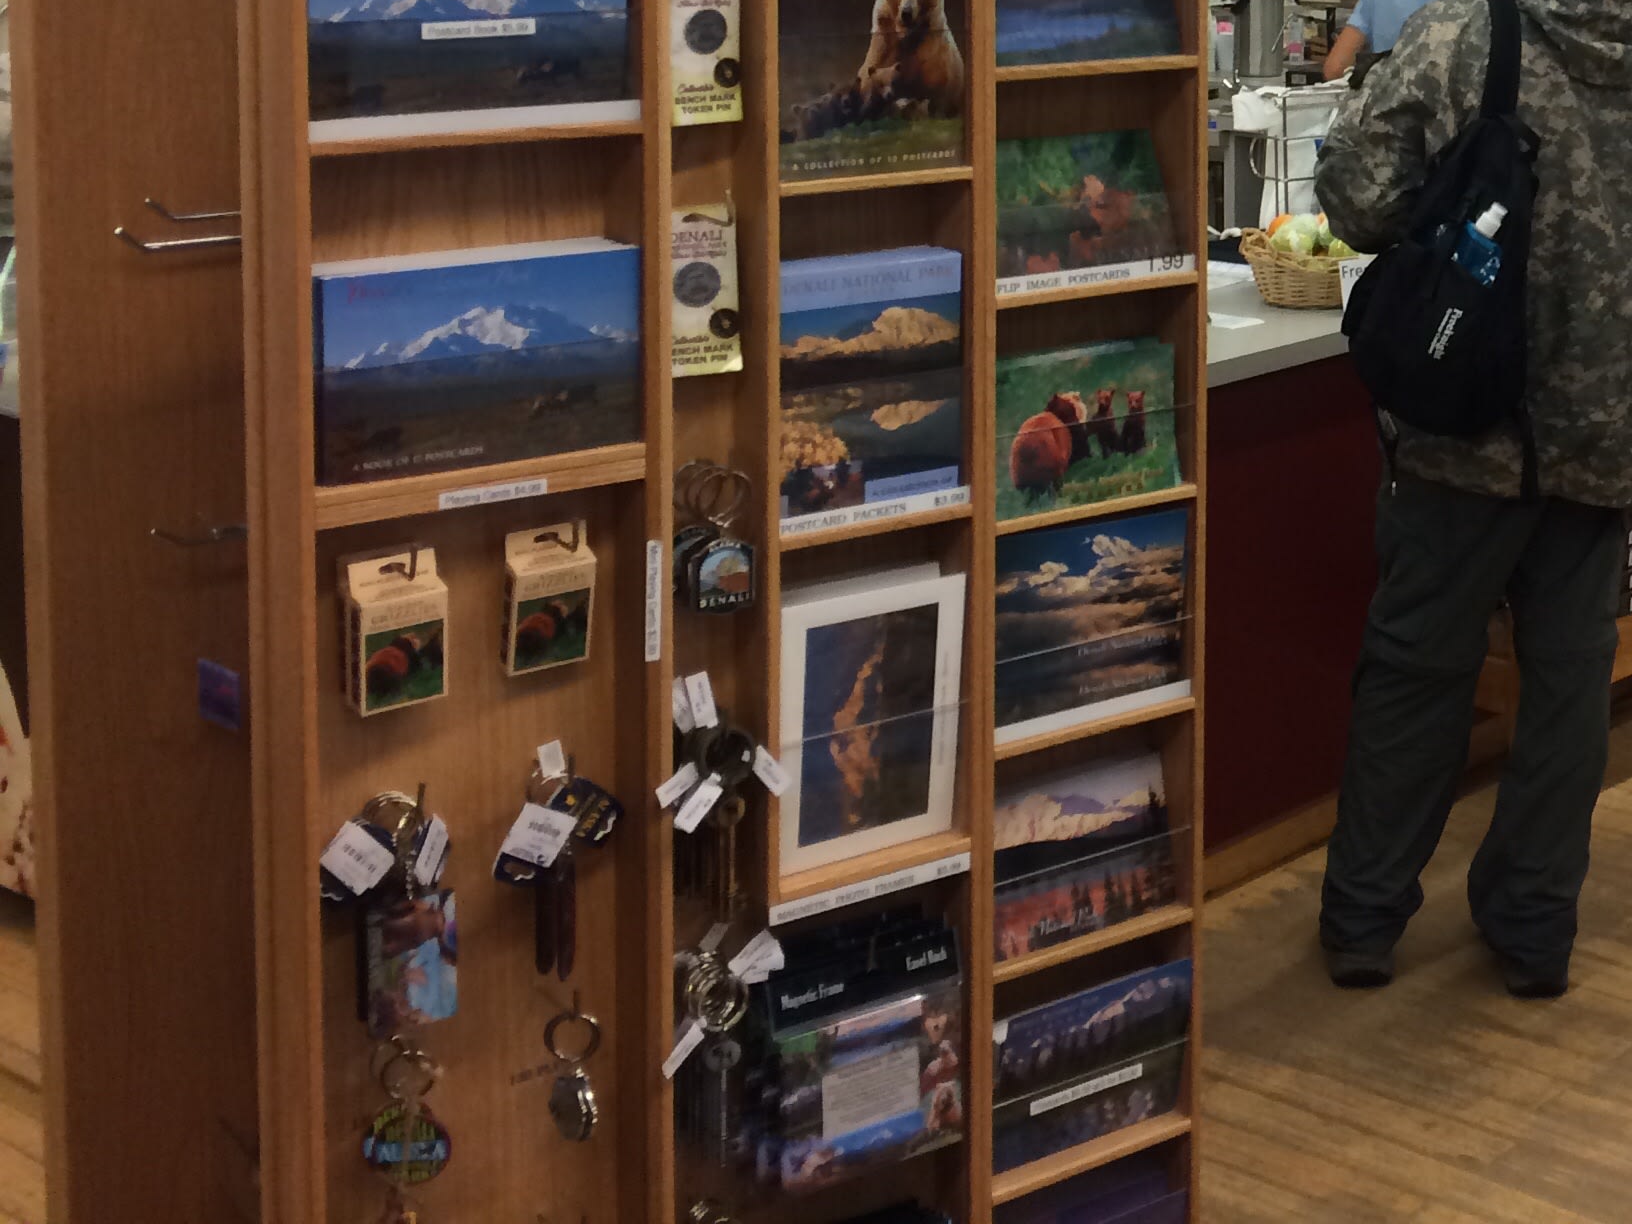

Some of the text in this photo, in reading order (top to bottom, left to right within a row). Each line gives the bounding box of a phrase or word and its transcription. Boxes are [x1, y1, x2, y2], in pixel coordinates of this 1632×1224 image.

[674, 93, 737, 106] BENCH MARK
[681, 102, 732, 115] TOKEN PIN
[996, 253, 1184, 294] FLIP IMAGE POSTCARDS 1.99
[1341, 265, 1366, 279] Fre
[672, 343, 734, 357] ENCH MARK
[710, 353, 729, 363] PIN
[781, 514, 848, 534] POSTCARD
[853, 502, 907, 522] PACKETS
[699, 592, 750, 609] DENALI
